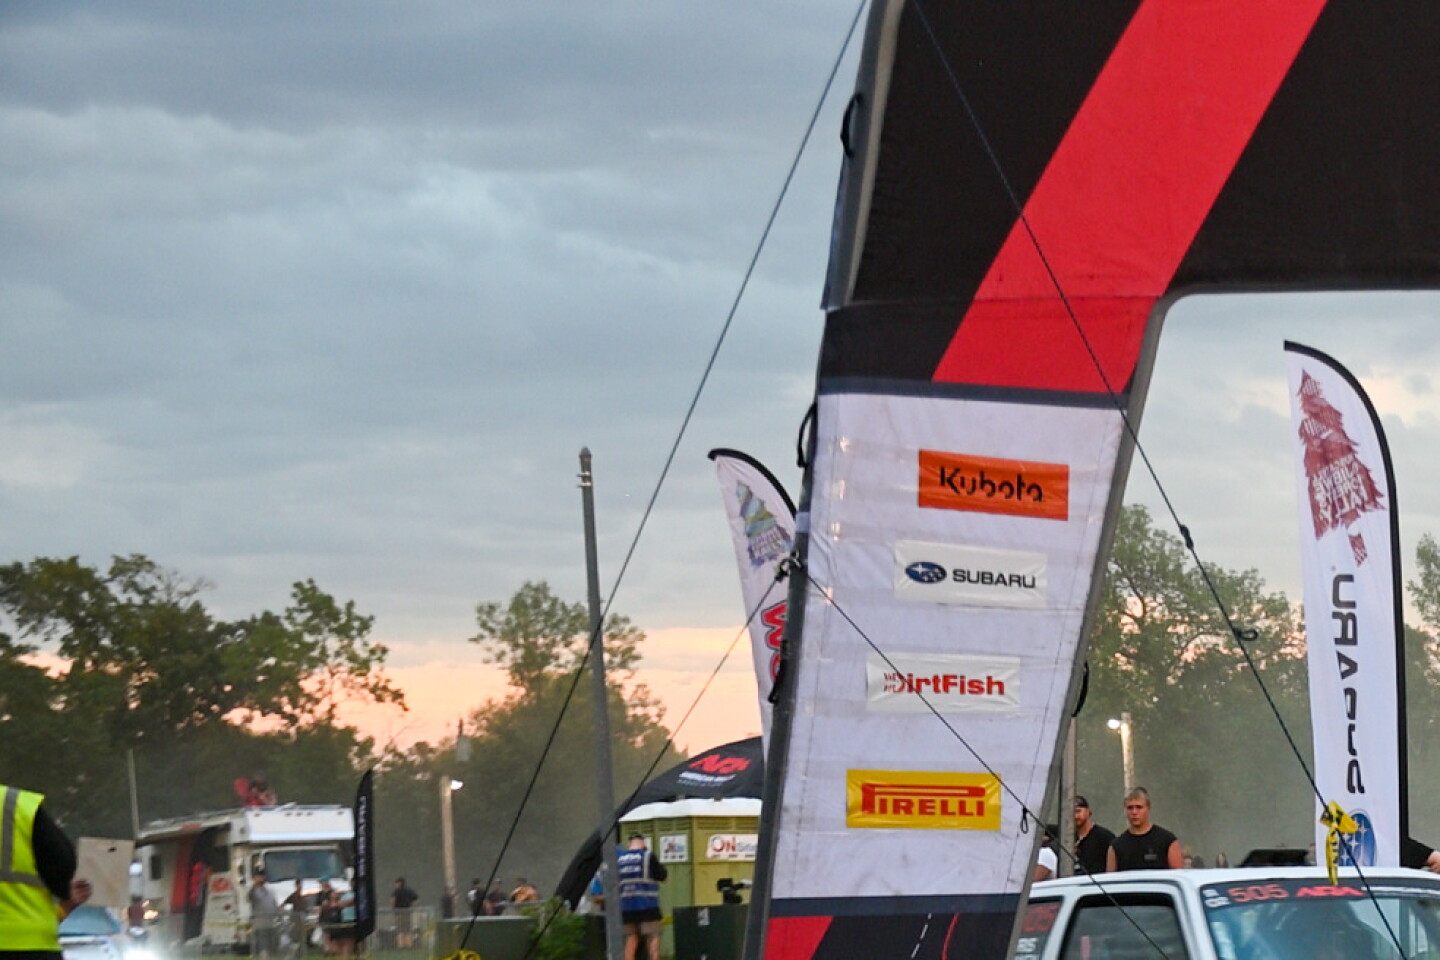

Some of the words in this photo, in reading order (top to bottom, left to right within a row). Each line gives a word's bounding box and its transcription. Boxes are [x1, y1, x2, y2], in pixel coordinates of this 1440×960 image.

[940, 466, 1043, 504] Kubota
[952, 568, 1036, 589] SUBARU
[883, 671, 1005, 696] DirtFish
[861, 783, 986, 817] PIRELLI
[1227, 884, 1289, 903] 505
